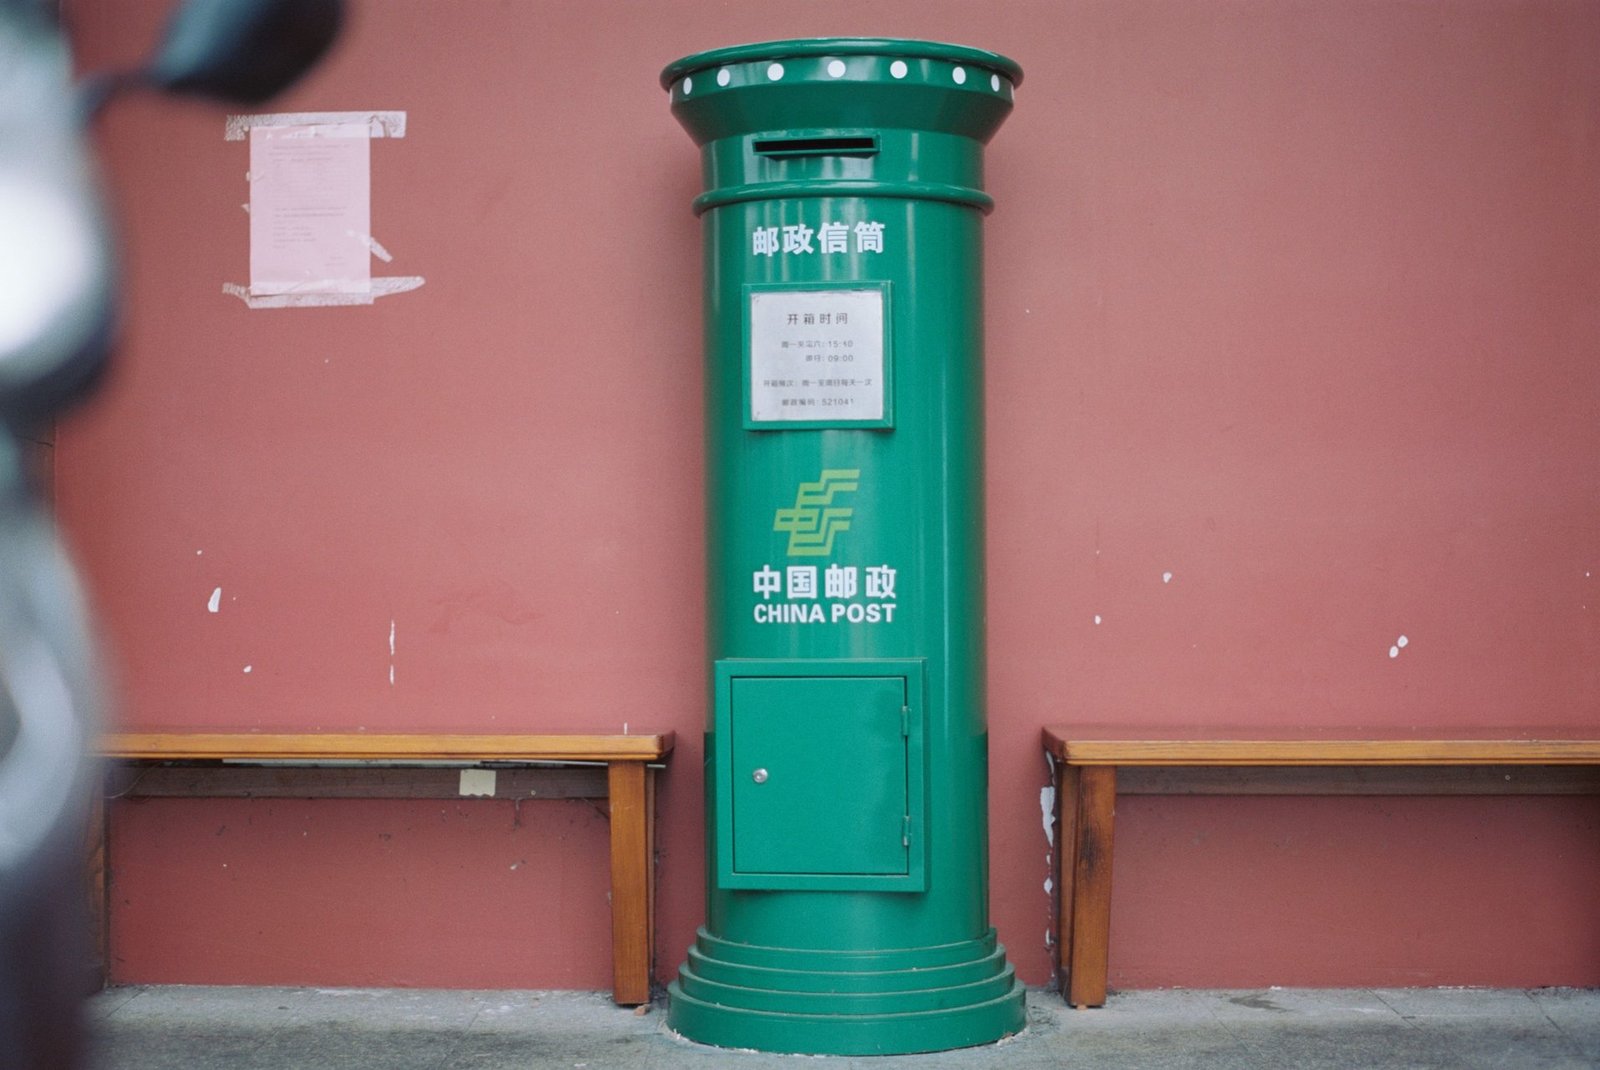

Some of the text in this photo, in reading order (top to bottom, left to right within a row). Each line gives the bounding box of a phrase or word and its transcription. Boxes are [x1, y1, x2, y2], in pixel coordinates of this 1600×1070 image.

[752, 221, 886, 257] 邮政信筒
[787, 312, 849, 325] 开箱时间
[752, 563, 897, 600] 中国邮政
[753, 603, 897, 624] CHINA POST
